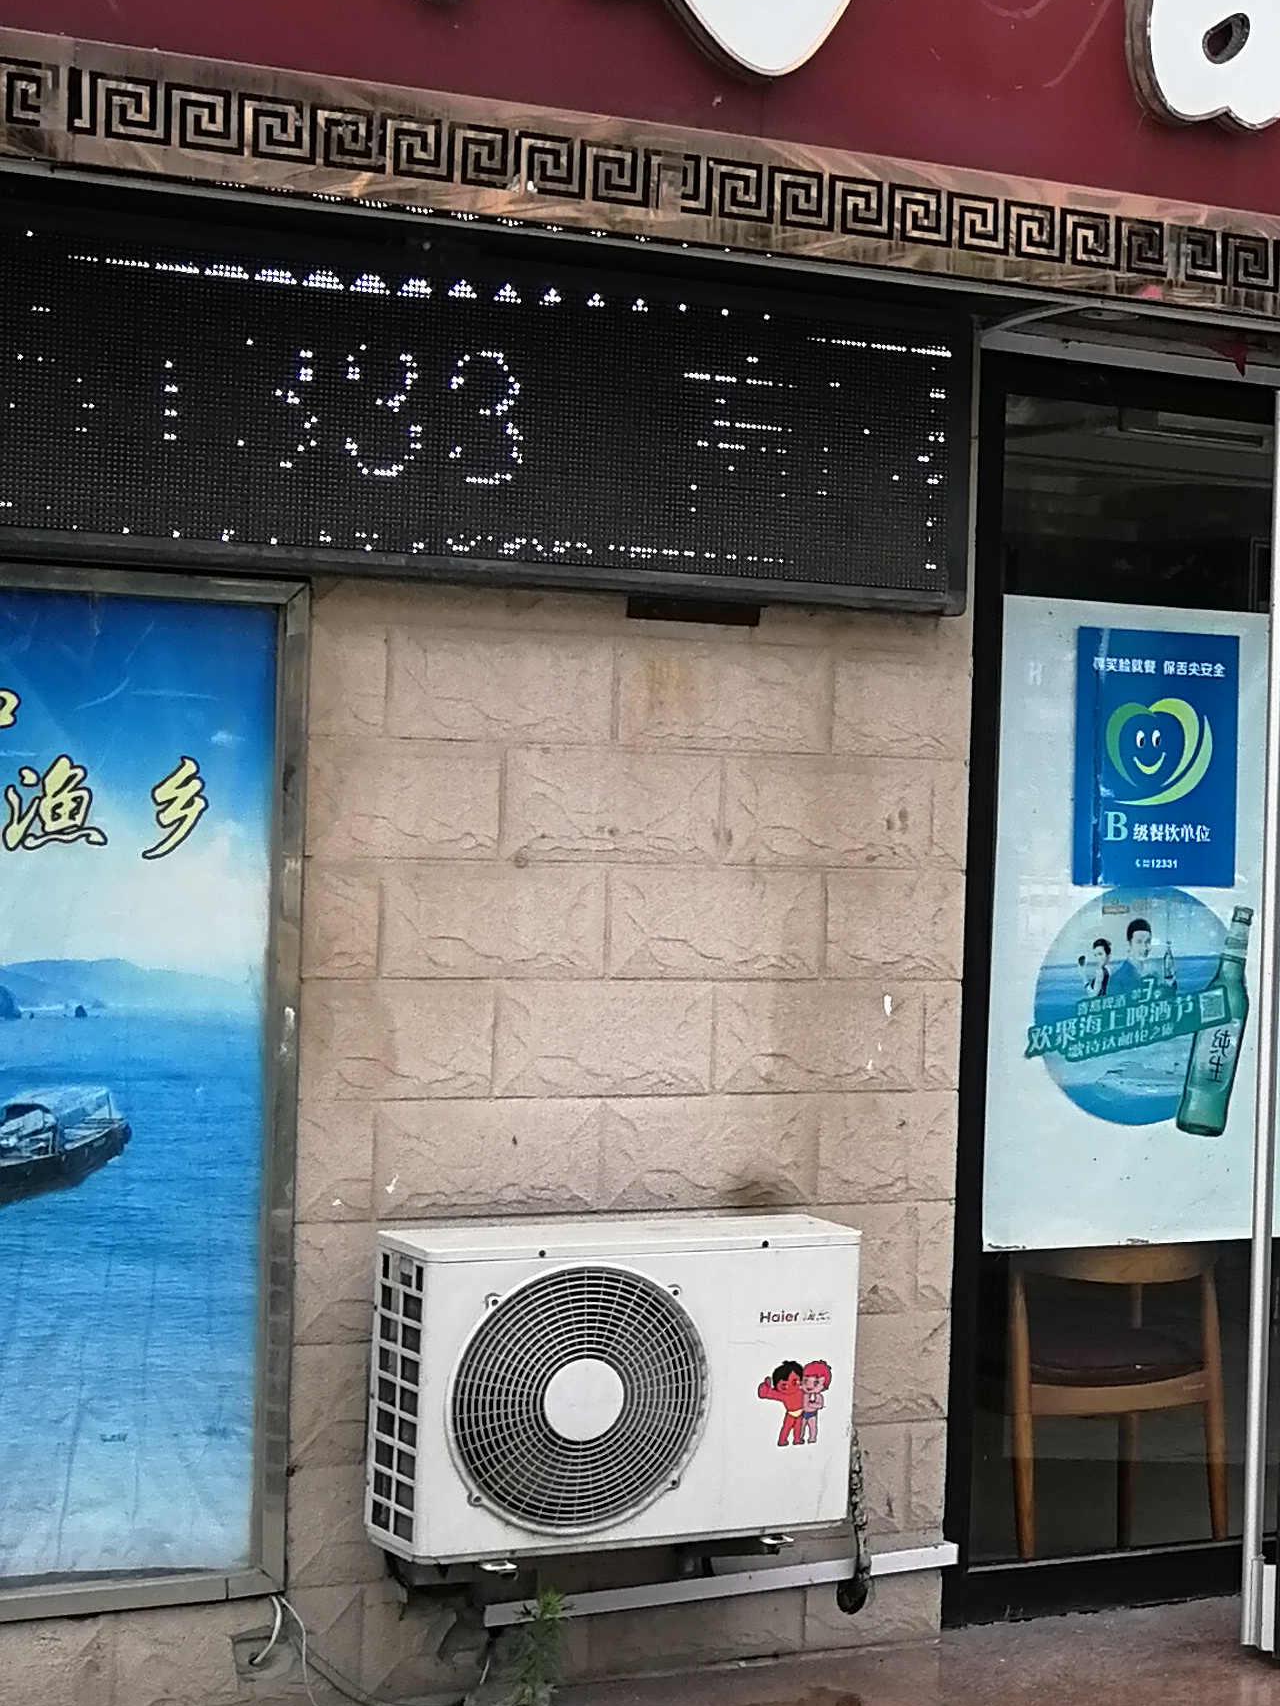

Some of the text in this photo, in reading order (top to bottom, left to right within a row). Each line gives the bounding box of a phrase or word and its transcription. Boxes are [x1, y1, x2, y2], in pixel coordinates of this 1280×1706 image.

[1162, 659, 1227, 679] 保舌尖安全
[1029, 993, 1195, 1051] 欢聚海上啤酒节
[1206, 1028, 1231, 1083] 纯生
[759, 1309, 800, 1324] Haier
